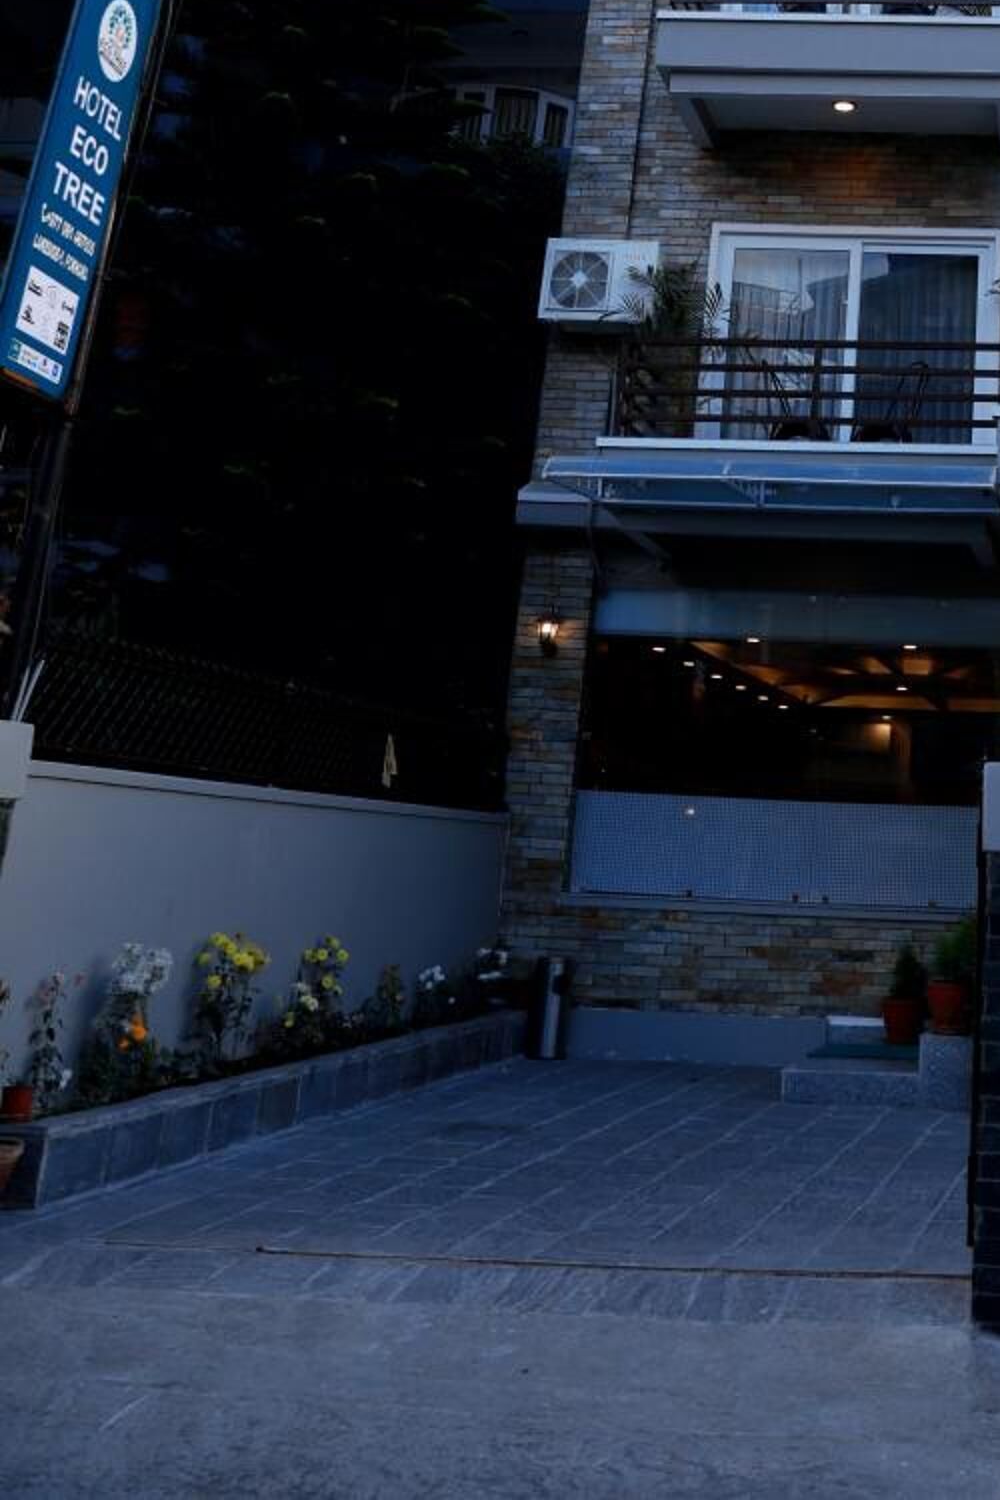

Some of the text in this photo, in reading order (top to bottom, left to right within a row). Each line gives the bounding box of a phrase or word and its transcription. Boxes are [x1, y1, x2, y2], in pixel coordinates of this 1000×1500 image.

[73, 76, 122, 141] HOTEL
[70, 124, 109, 175] ECO
[53, 161, 105, 226] TREE
